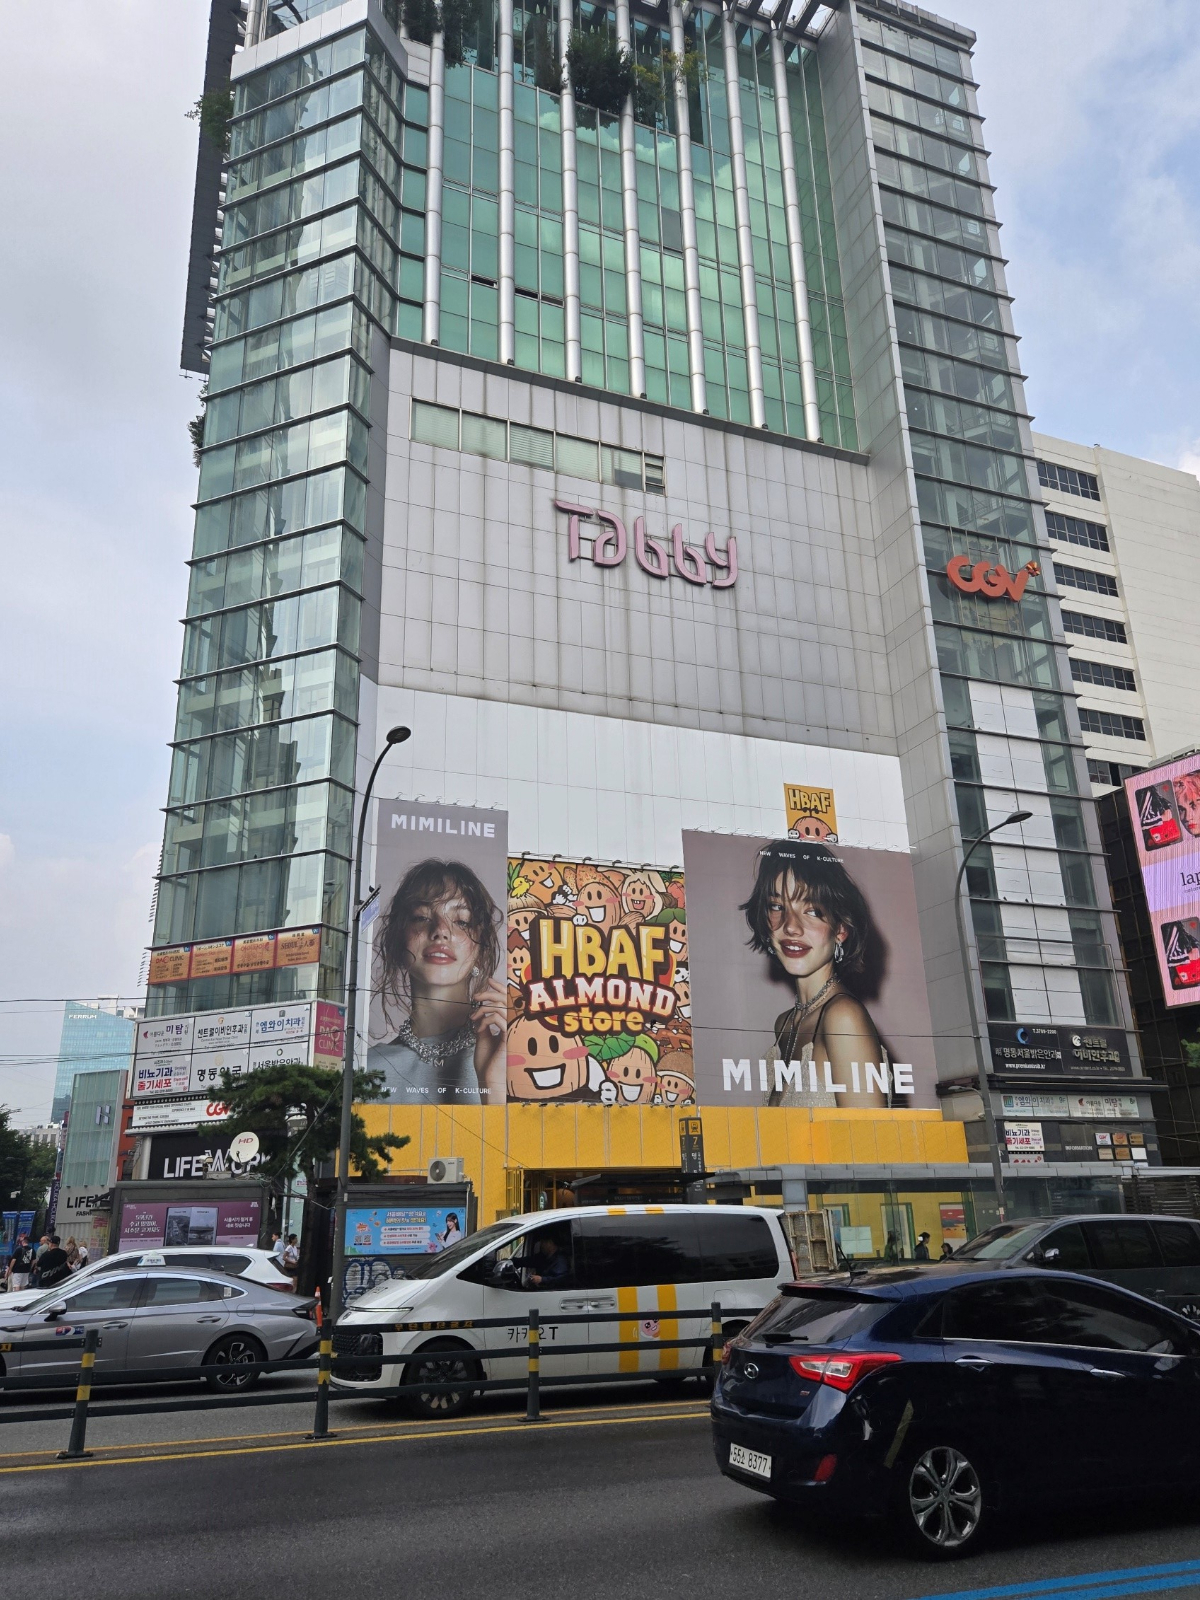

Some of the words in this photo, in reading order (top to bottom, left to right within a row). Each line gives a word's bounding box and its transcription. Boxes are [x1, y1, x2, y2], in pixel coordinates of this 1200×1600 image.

[554, 500, 739, 589] Tabby
[946, 555, 1031, 603] CGV
[788, 788, 831, 813] HBAF
[391, 813, 496, 838] MIMILINE
[538, 917, 668, 981] HBAF
[529, 975, 677, 1017] ALMOND
[286, 1017, 301, 1027] 치과
[563, 1007, 644, 1033] store
[138, 1066, 173, 1079] 비뇨기과
[722, 1058, 915, 1094] MIMILINE
[137, 1078, 172, 1091] 줄기세포
[455, 1087, 492, 1095] K-CULTURE
[206, 1102, 231, 1117] CGV
[238, 1137, 254, 1145] HD
[692, 1136, 698, 1145] 7
[1005, 1129, 1031, 1137] 비뇨기과
[549, 1326, 559, 1340] T
[733, 1446, 746, 1465] 55소
[748, 1452, 768, 1473] 8377
